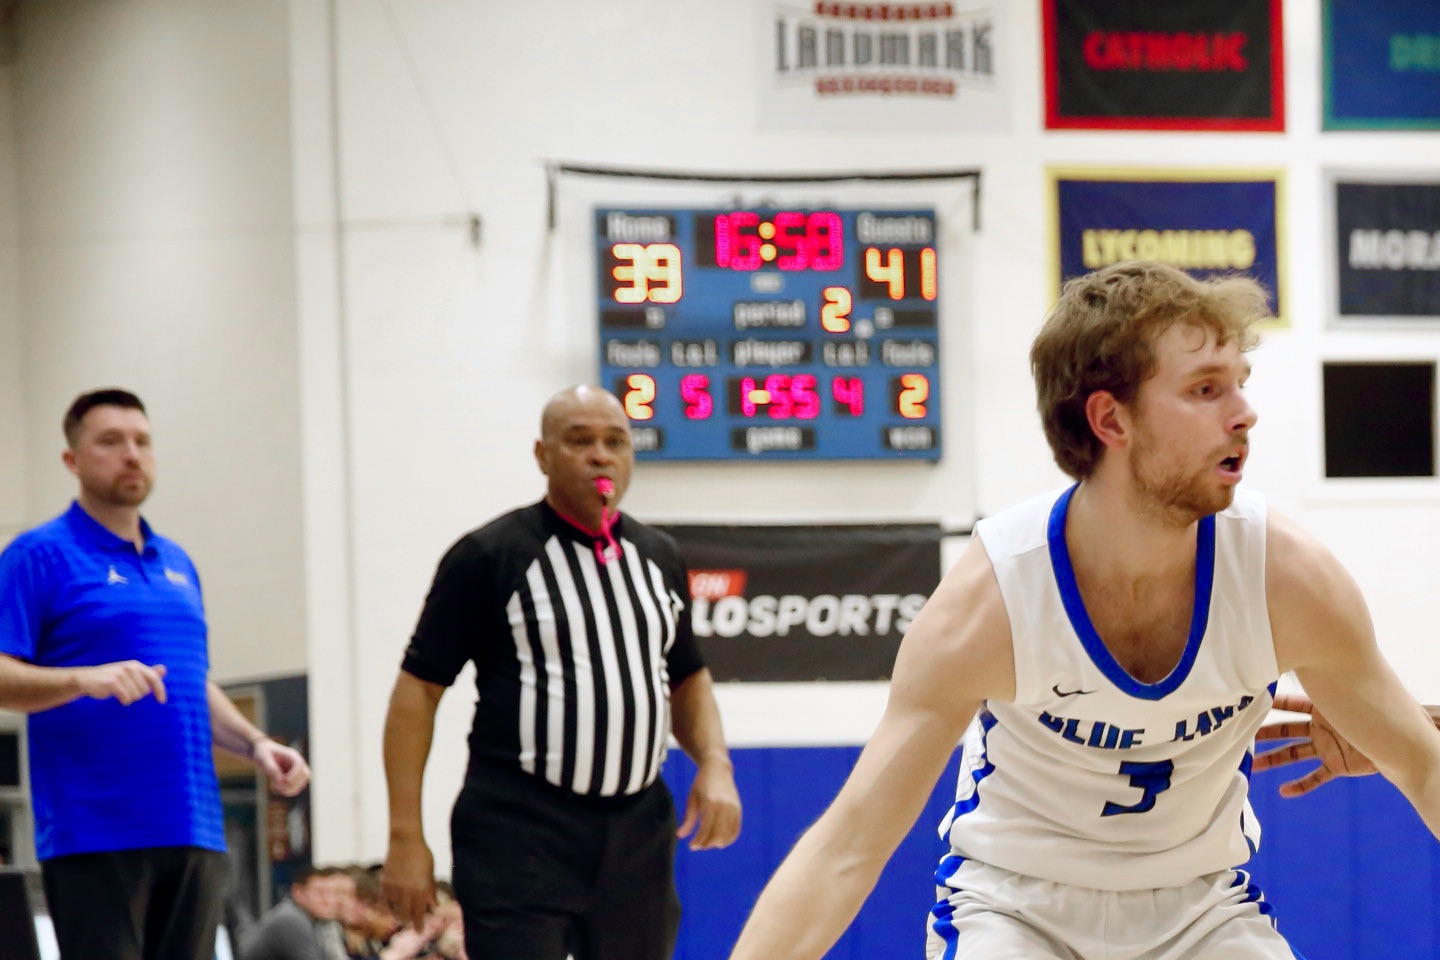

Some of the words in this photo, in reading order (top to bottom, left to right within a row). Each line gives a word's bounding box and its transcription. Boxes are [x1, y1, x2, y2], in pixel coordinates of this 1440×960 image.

[775, 16, 995, 76] LANDMARK
[1082, 31, 1248, 71] CATHOLIC
[1082, 228, 1256, 270] LYCOMING
[612, 243, 683, 304] 39
[866, 247, 937, 300] 41
[821, 286, 852, 333] 2
[624, 373, 656, 420] 2
[680, 373, 713, 420] 5
[832, 375, 864, 417] 4
[899, 373, 930, 419] 2
